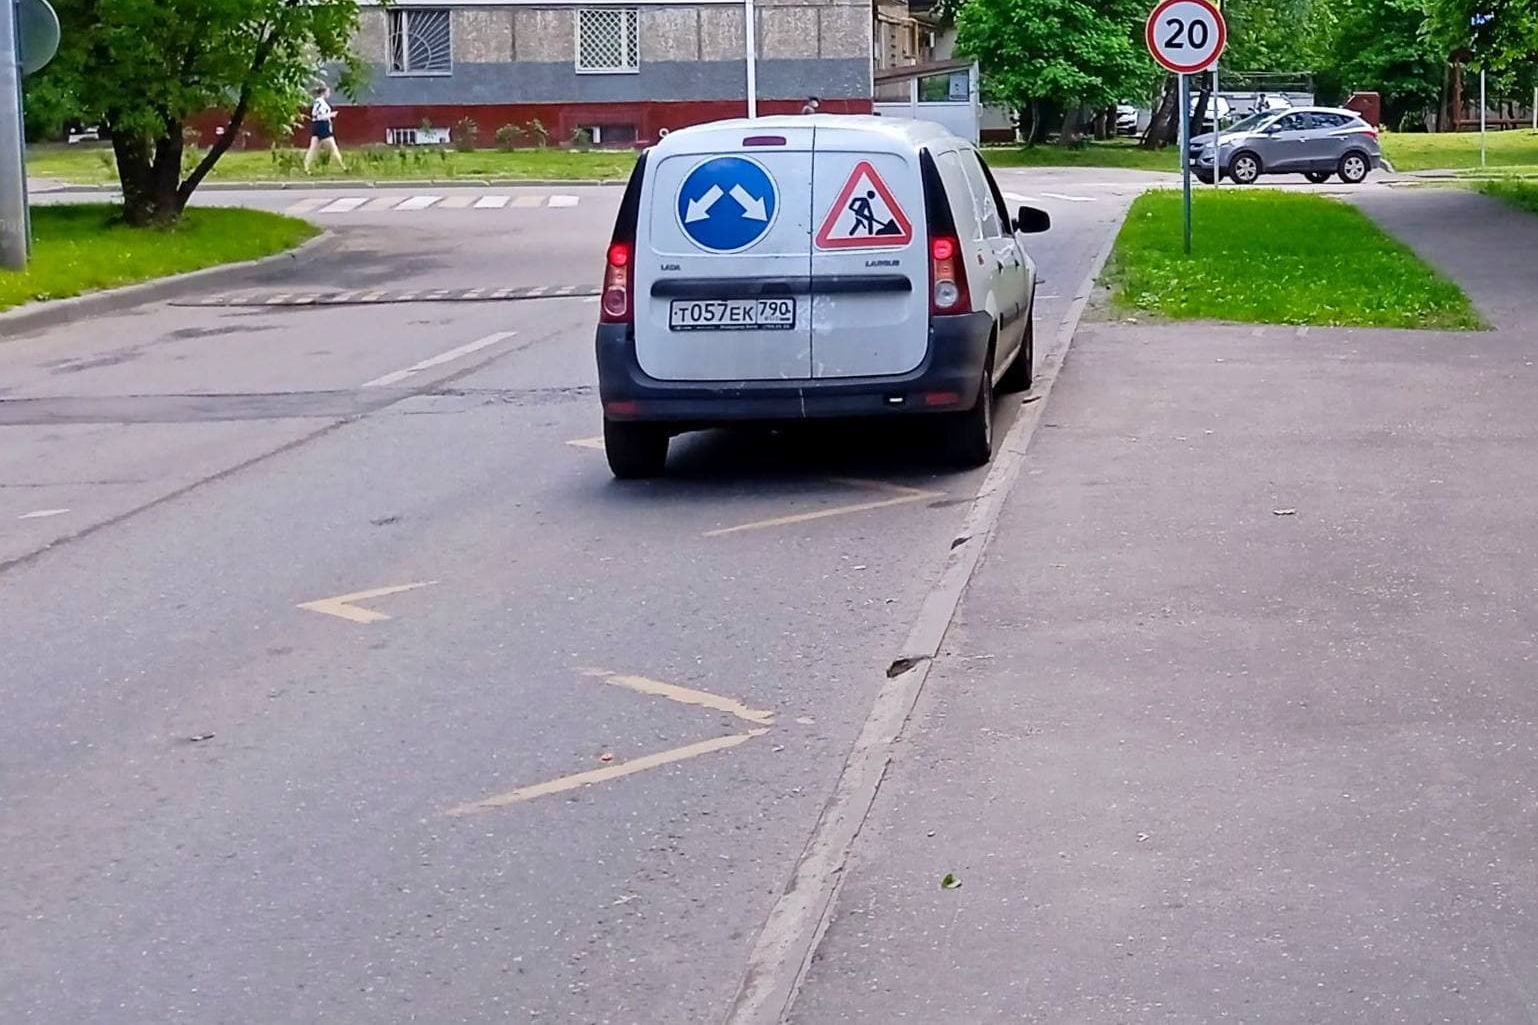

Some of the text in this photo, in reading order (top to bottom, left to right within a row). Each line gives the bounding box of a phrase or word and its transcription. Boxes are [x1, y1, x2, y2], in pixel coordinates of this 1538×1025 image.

[1164, 18, 1209, 50] 20
[679, 301, 789, 323] Т057ЕК 790
